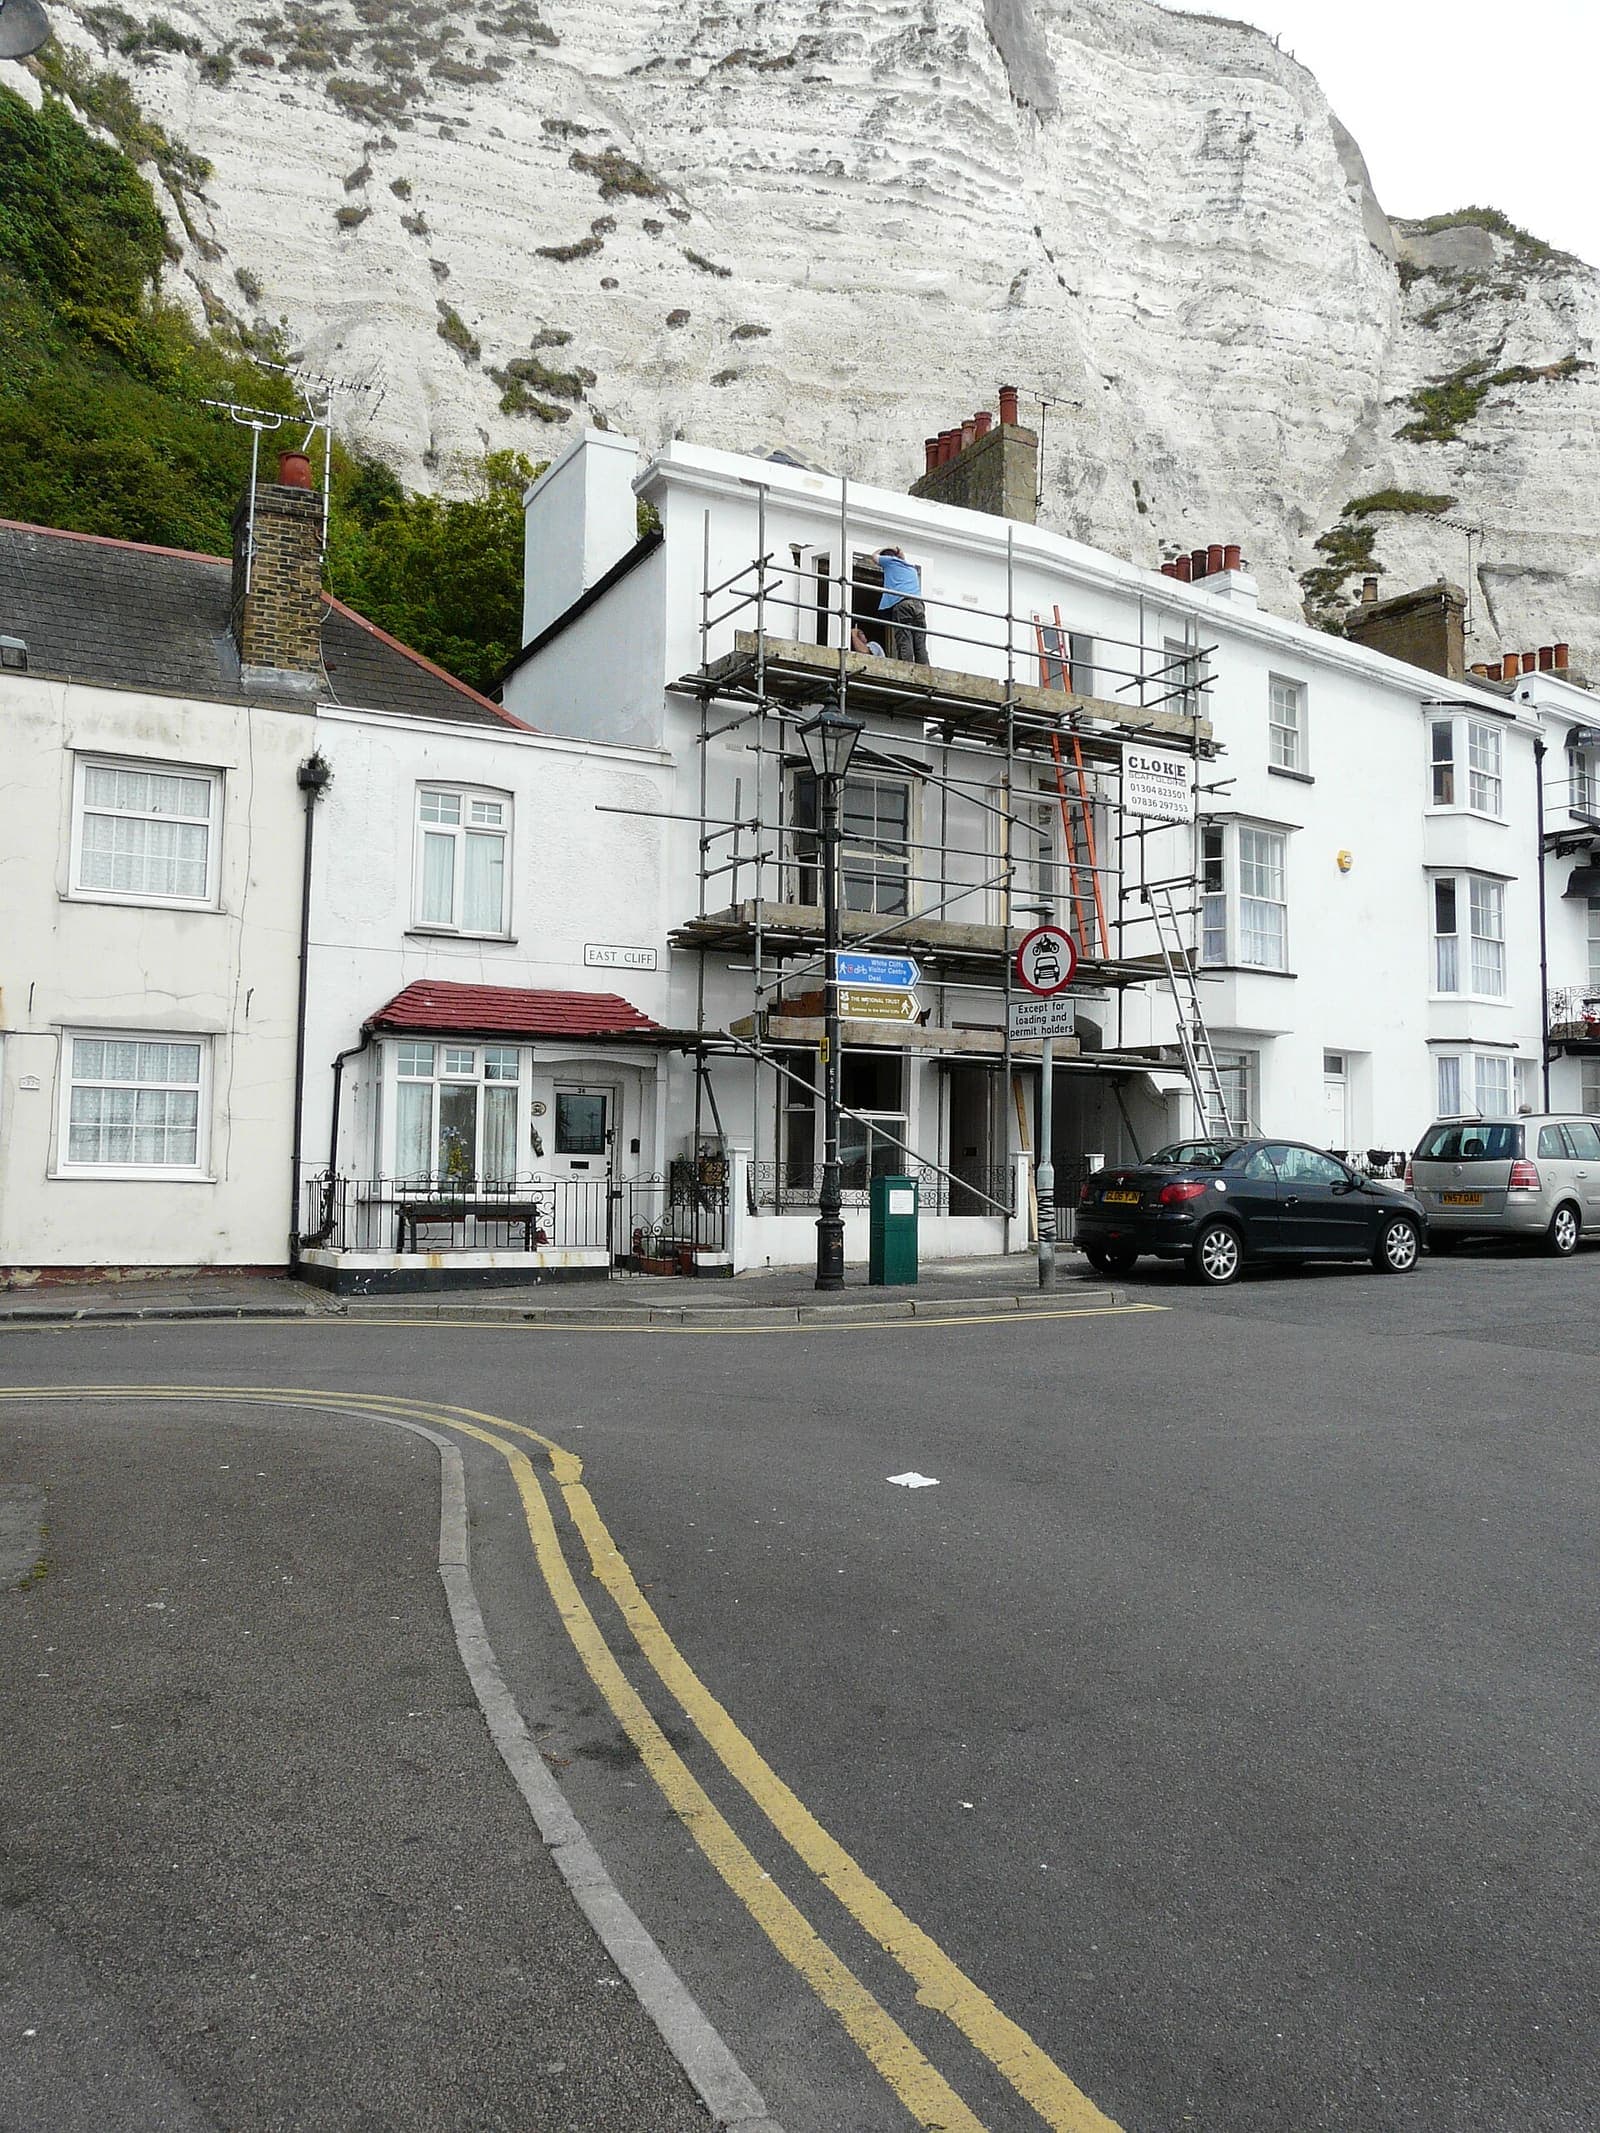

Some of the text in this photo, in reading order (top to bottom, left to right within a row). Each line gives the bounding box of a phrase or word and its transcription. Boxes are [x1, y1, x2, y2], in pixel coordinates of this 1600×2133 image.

[1128, 756, 1186, 777] CLOKE
[1128, 771, 1187, 787] SCAFFOLDING
[1130, 783, 1186, 799] 01304 823501
[1131, 796, 1158, 808] 07836
[589, 950, 653, 964] EAST CLIFF
[860, 996, 885, 1004] NATIONAL
[1018, 1002, 1065, 1013] Except for
[1015, 1012, 1067, 1025] loading and
[1010, 1024, 1073, 1038] permit holders
